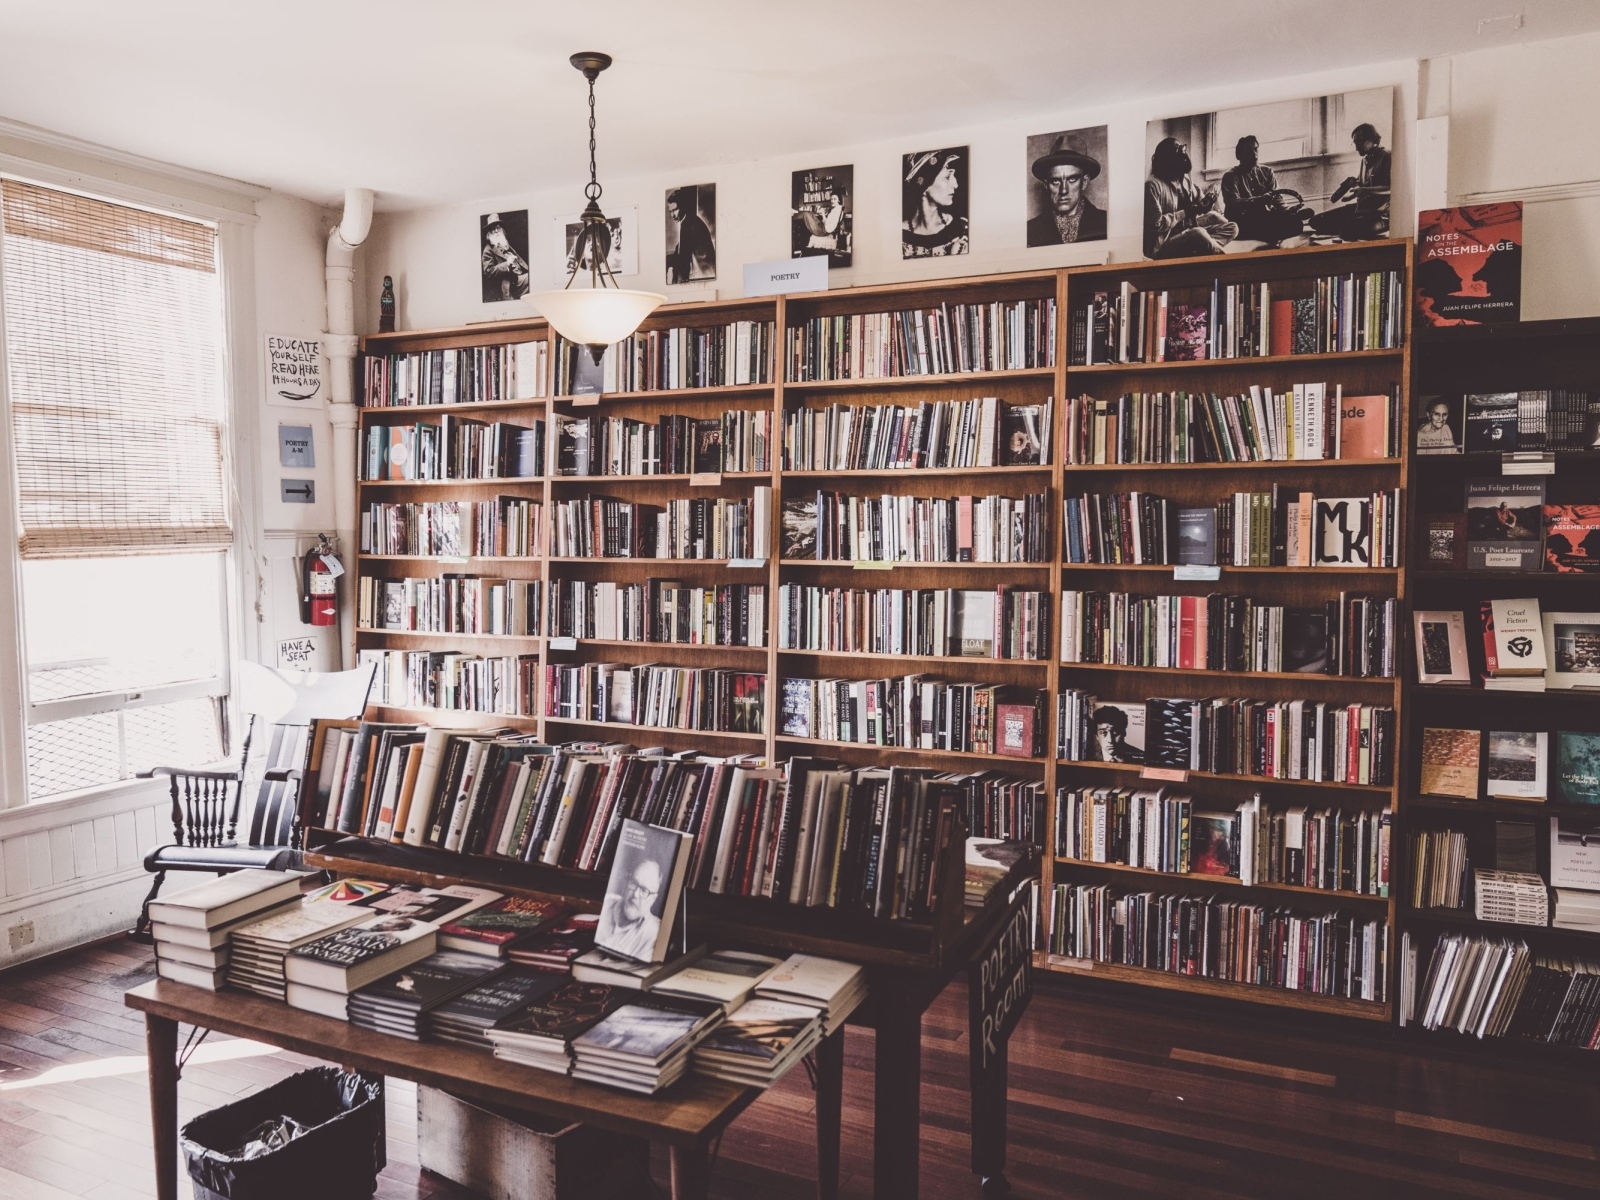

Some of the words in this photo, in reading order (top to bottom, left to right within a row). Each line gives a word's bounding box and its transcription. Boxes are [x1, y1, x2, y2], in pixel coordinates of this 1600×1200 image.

[1426, 233, 1459, 242] NOTES
[1427, 242, 1514, 258] ASSEMBLAGE
[771, 273, 801, 281] POETRY
[269, 337, 320, 355] EDUCATE
[269, 349, 316, 363] YOURSELF
[271, 362, 298, 375] READ
[299, 363, 320, 377] HERE
[272, 374, 280, 385] 14
[303, 377, 309, 386] A
[309, 378, 321, 387] DAY
[1307, 393, 1315, 426] KENNETH
[1307, 429, 1315, 448] KOCH
[1488, 484, 1510, 493] Felipe
[281, 640, 303, 657] HAVE
[305, 639, 316, 652] A
[962, 639, 985, 649] FLOAT
[287, 651, 311, 662] SEAT
[1097, 806, 1105, 846] MACHADO
[981, 893, 1031, 1012] POETRY
